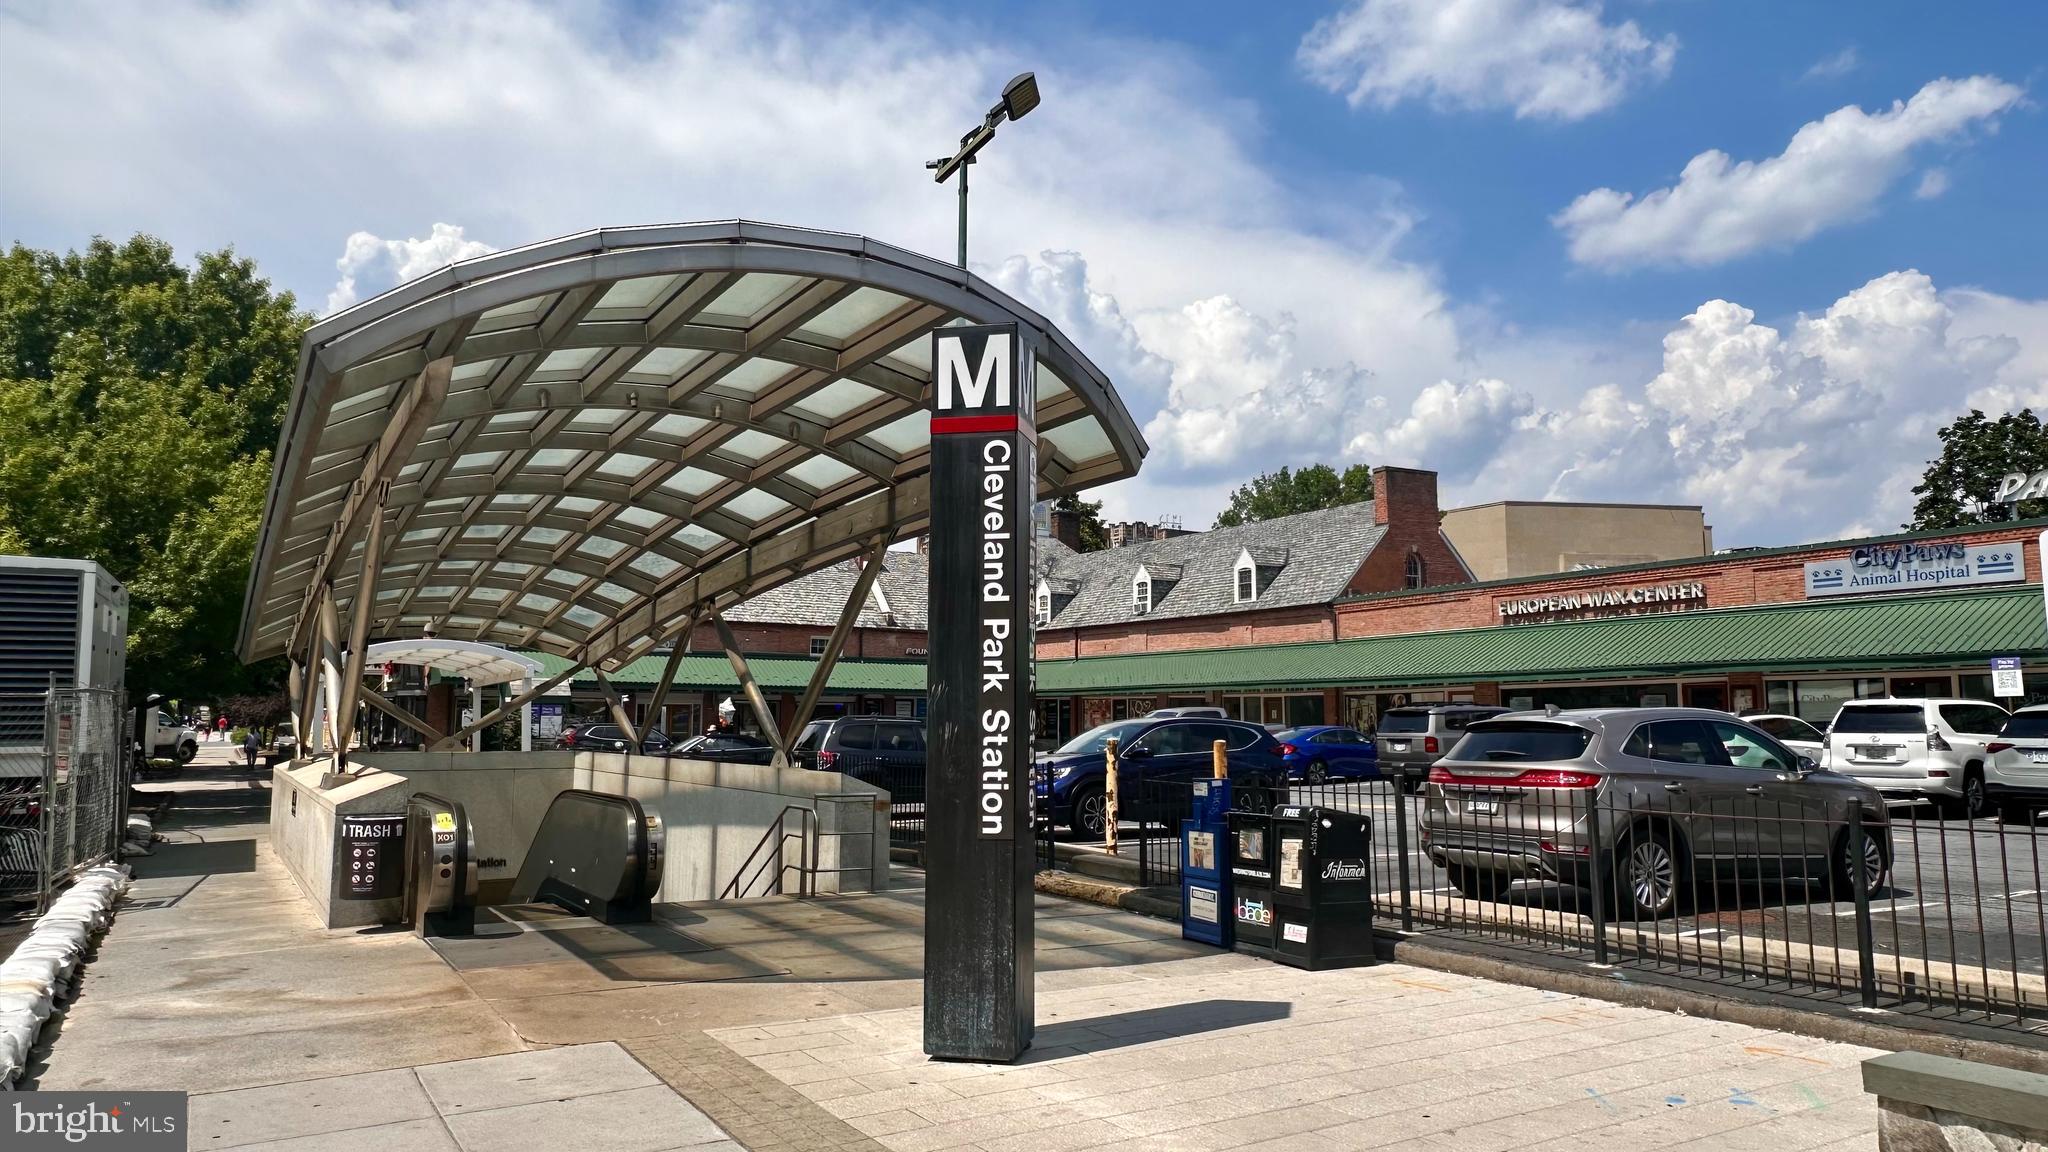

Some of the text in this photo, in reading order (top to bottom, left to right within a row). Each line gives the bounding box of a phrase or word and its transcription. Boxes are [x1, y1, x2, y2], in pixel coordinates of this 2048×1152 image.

[938, 334, 1011, 410] M
[1851, 543, 1965, 569] CityPaws
[1850, 566, 1970, 586] Animal Hospital
[1498, 583, 1705, 616] EUROPEAN WAX CENTER
[982, 440, 1011, 835] Cleveland Park Station
[906, 647, 928, 655] FOUN
[1282, 808, 1300, 817] FREE
[350, 824, 391, 838] TRASH
[477, 857, 507, 868] tation
[1237, 897, 1271, 924] blade
